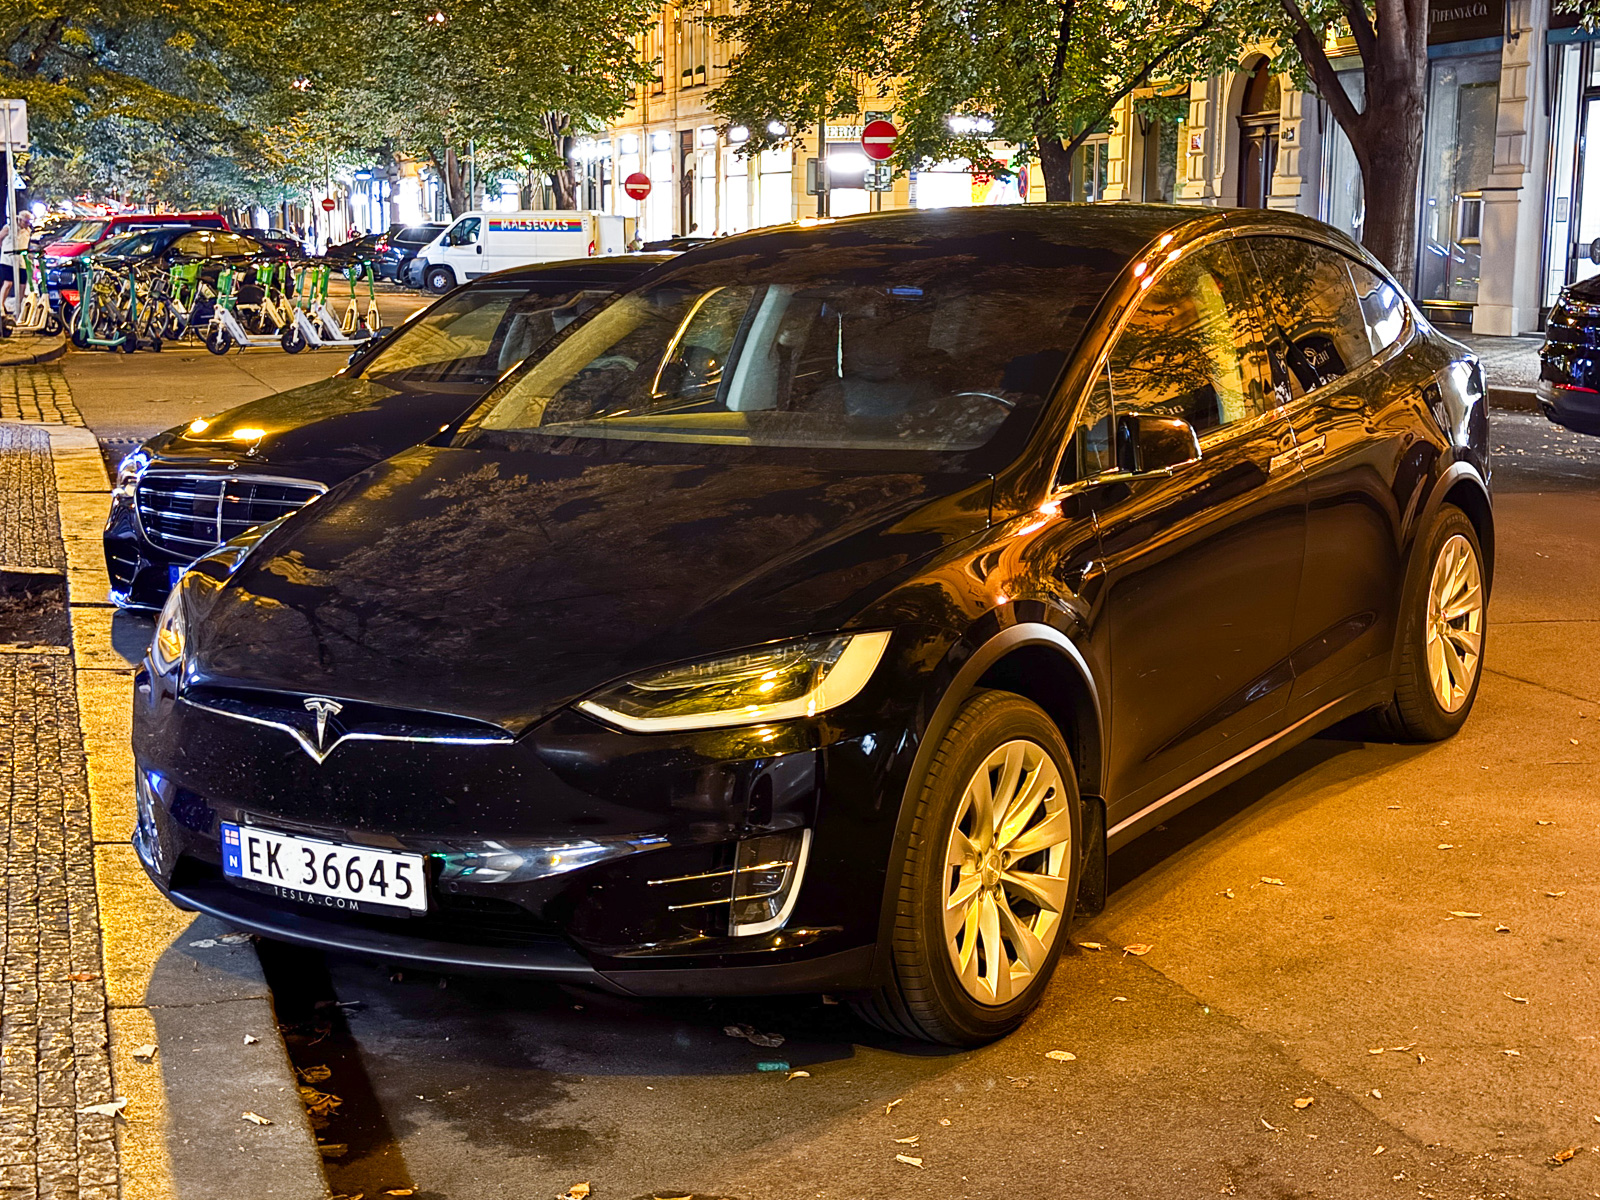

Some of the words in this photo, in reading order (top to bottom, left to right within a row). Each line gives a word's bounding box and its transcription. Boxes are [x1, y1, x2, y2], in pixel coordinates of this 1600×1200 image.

[500, 219, 569, 231] MALSERVIS
[229, 854, 239, 868] N
[248, 836, 284, 880] EK
[301, 847, 413, 900] 36645
[274, 886, 360, 911] TESLA.COM
